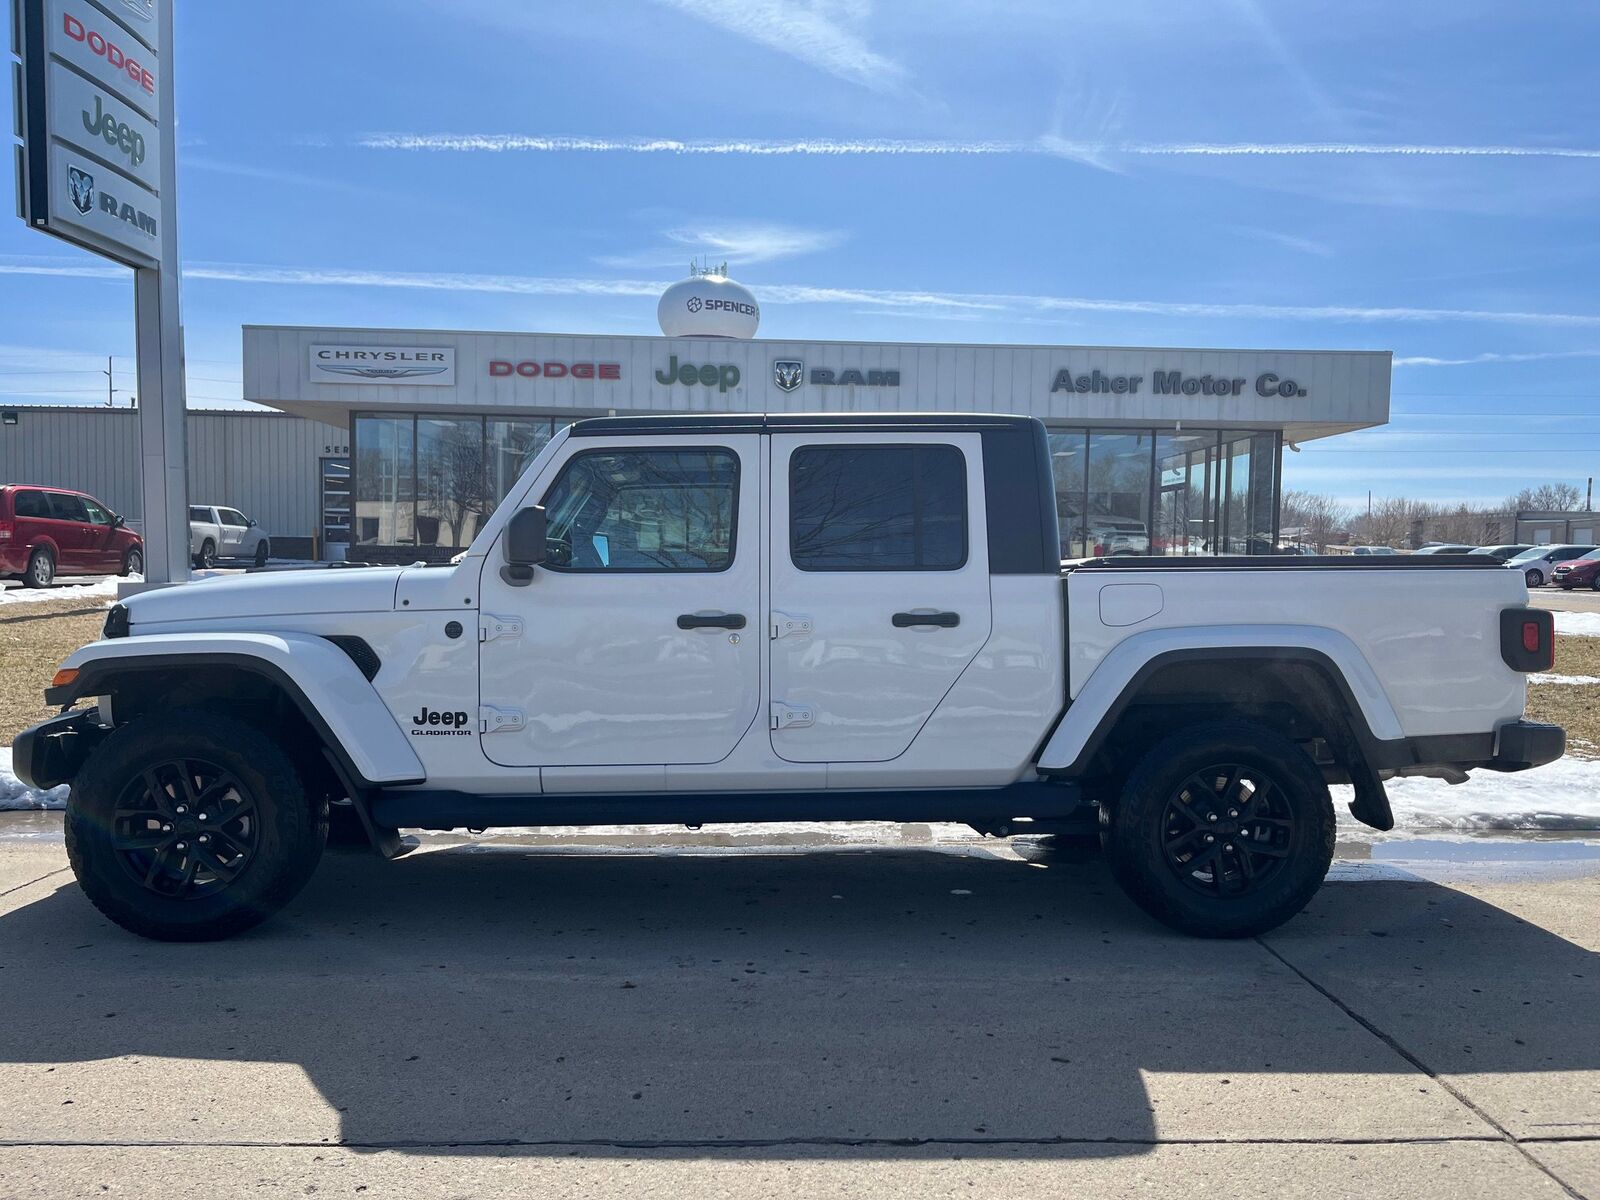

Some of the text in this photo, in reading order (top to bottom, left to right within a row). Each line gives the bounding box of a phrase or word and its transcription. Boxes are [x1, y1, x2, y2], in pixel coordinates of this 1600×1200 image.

[64, 12, 155, 96] DODGE
[82, 95, 146, 168] Jeep
[100, 191, 157, 236] RAM
[704, 299, 756, 317] SPENCER
[318, 350, 445, 361] CHRYSLER
[489, 361, 621, 380] DODGE
[655, 355, 741, 393] Jeep
[810, 369, 900, 387] RAM
[1051, 368, 1307, 398] Asher Motor Co.
[413, 707, 468, 729] Jeep
